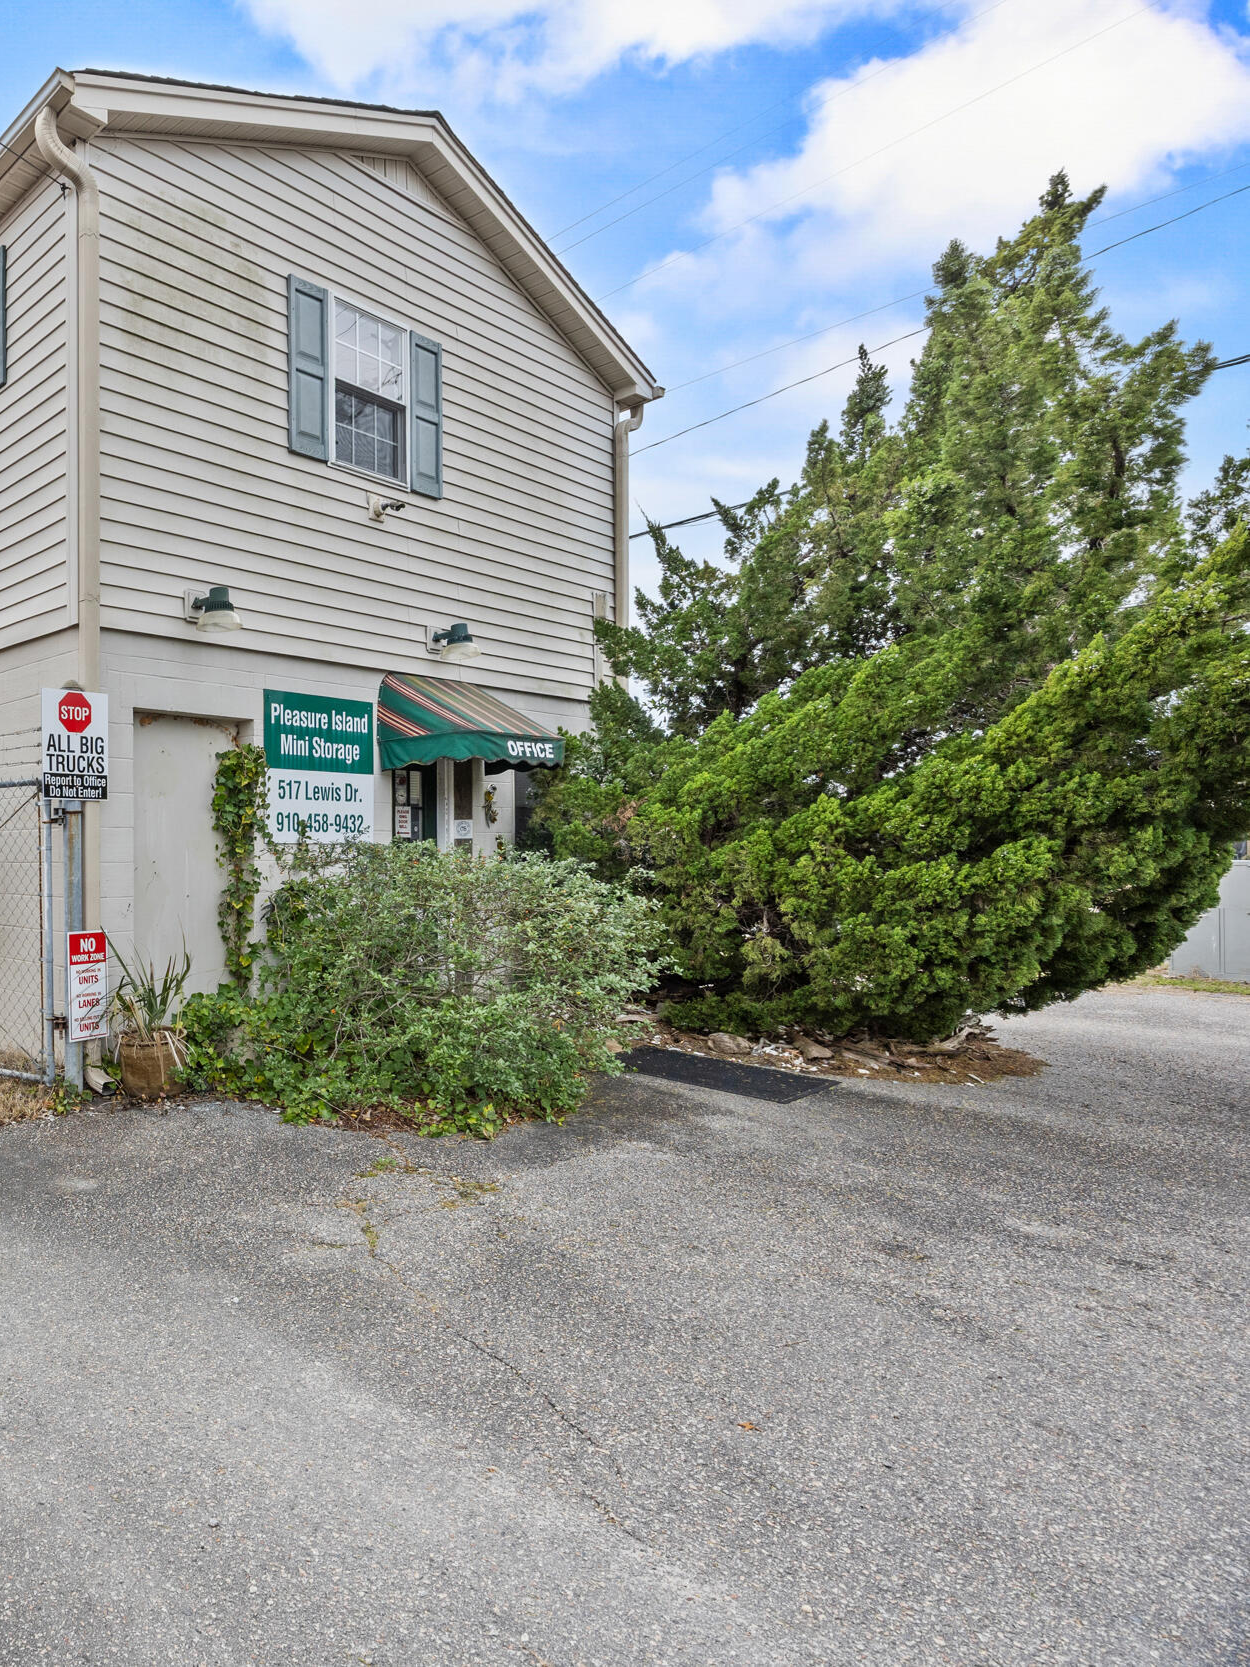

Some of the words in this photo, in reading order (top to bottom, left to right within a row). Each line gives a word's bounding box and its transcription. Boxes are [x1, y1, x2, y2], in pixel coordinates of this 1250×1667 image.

[60, 705, 90, 721] STOP
[271, 703, 328, 730] Pleasure
[331, 710, 368, 734] Island
[46, 733, 75, 753] ALL
[80, 736, 104, 755] BIG
[280, 733, 309, 757] Mini
[312, 736, 360, 764] Storage
[507, 740, 554, 758] OFFICE
[46, 753, 105, 774] TRUCKS
[45, 773, 72, 788] Report
[73, 776, 81, 786] to
[83, 776, 106, 788] Office
[50, 786, 61, 797] Do
[62, 786, 77, 798] Not
[77, 787, 102, 798] Enter!
[278, 779, 301, 800] 517
[305, 780, 341, 801] Lewis
[345, 783, 362, 803] Dr.
[276, 811, 364, 833] 910458-9432
[79, 937, 96, 953] NO
[71, 954, 89, 963] WORK
[90, 952, 105, 961] ZONE
[78, 975, 99, 984] UNITS
[78, 998, 100, 1009] LANES
[79, 1021, 100, 1032] UNITS
